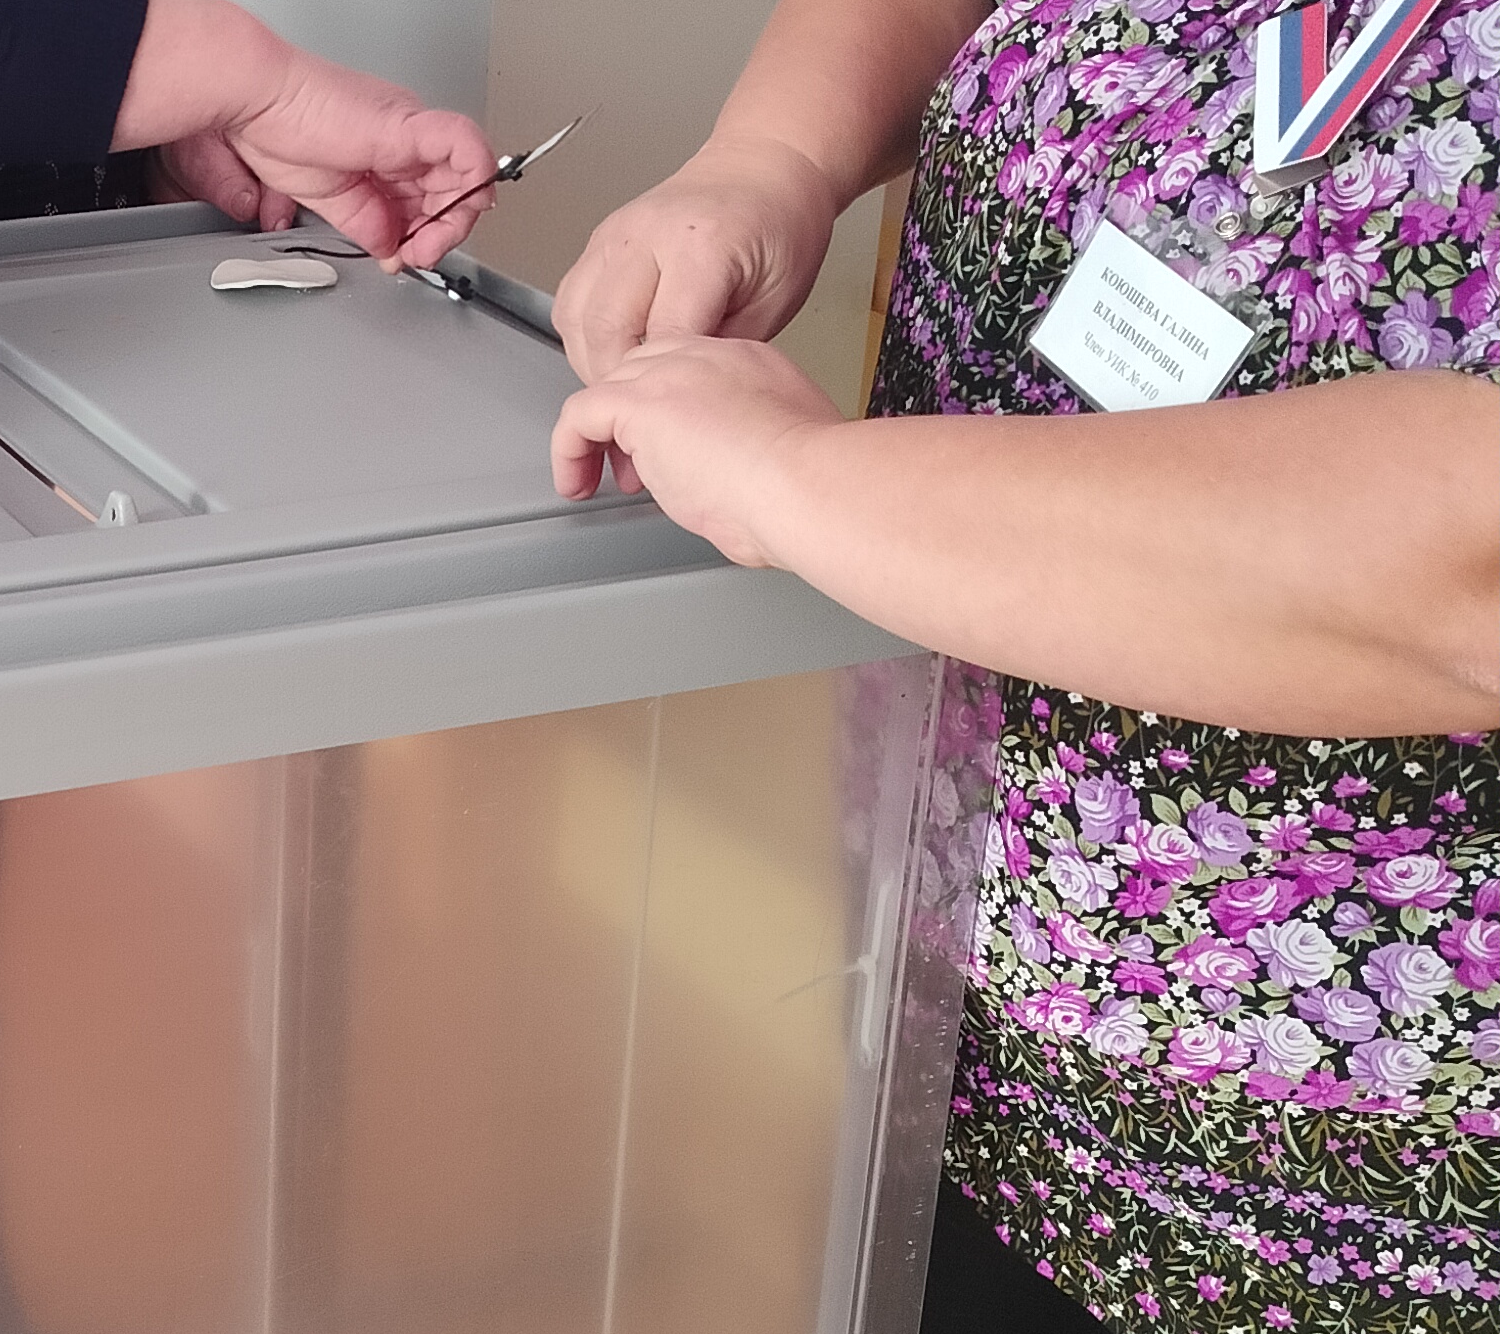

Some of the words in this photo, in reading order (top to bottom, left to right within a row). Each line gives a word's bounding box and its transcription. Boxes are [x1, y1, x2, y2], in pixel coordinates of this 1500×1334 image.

[1093, 299, 1185, 383] ВЛАДИМИРОВНА
[1100, 266, 1161, 322] КОЮШЕВА
[1160, 313, 1210, 361] ГАЛИНА
[1084, 331, 1106, 358] Член
[1104, 349, 1131, 377] УИК
[1125, 369, 1141, 387] №
[1139, 381, 1160, 401] 410
